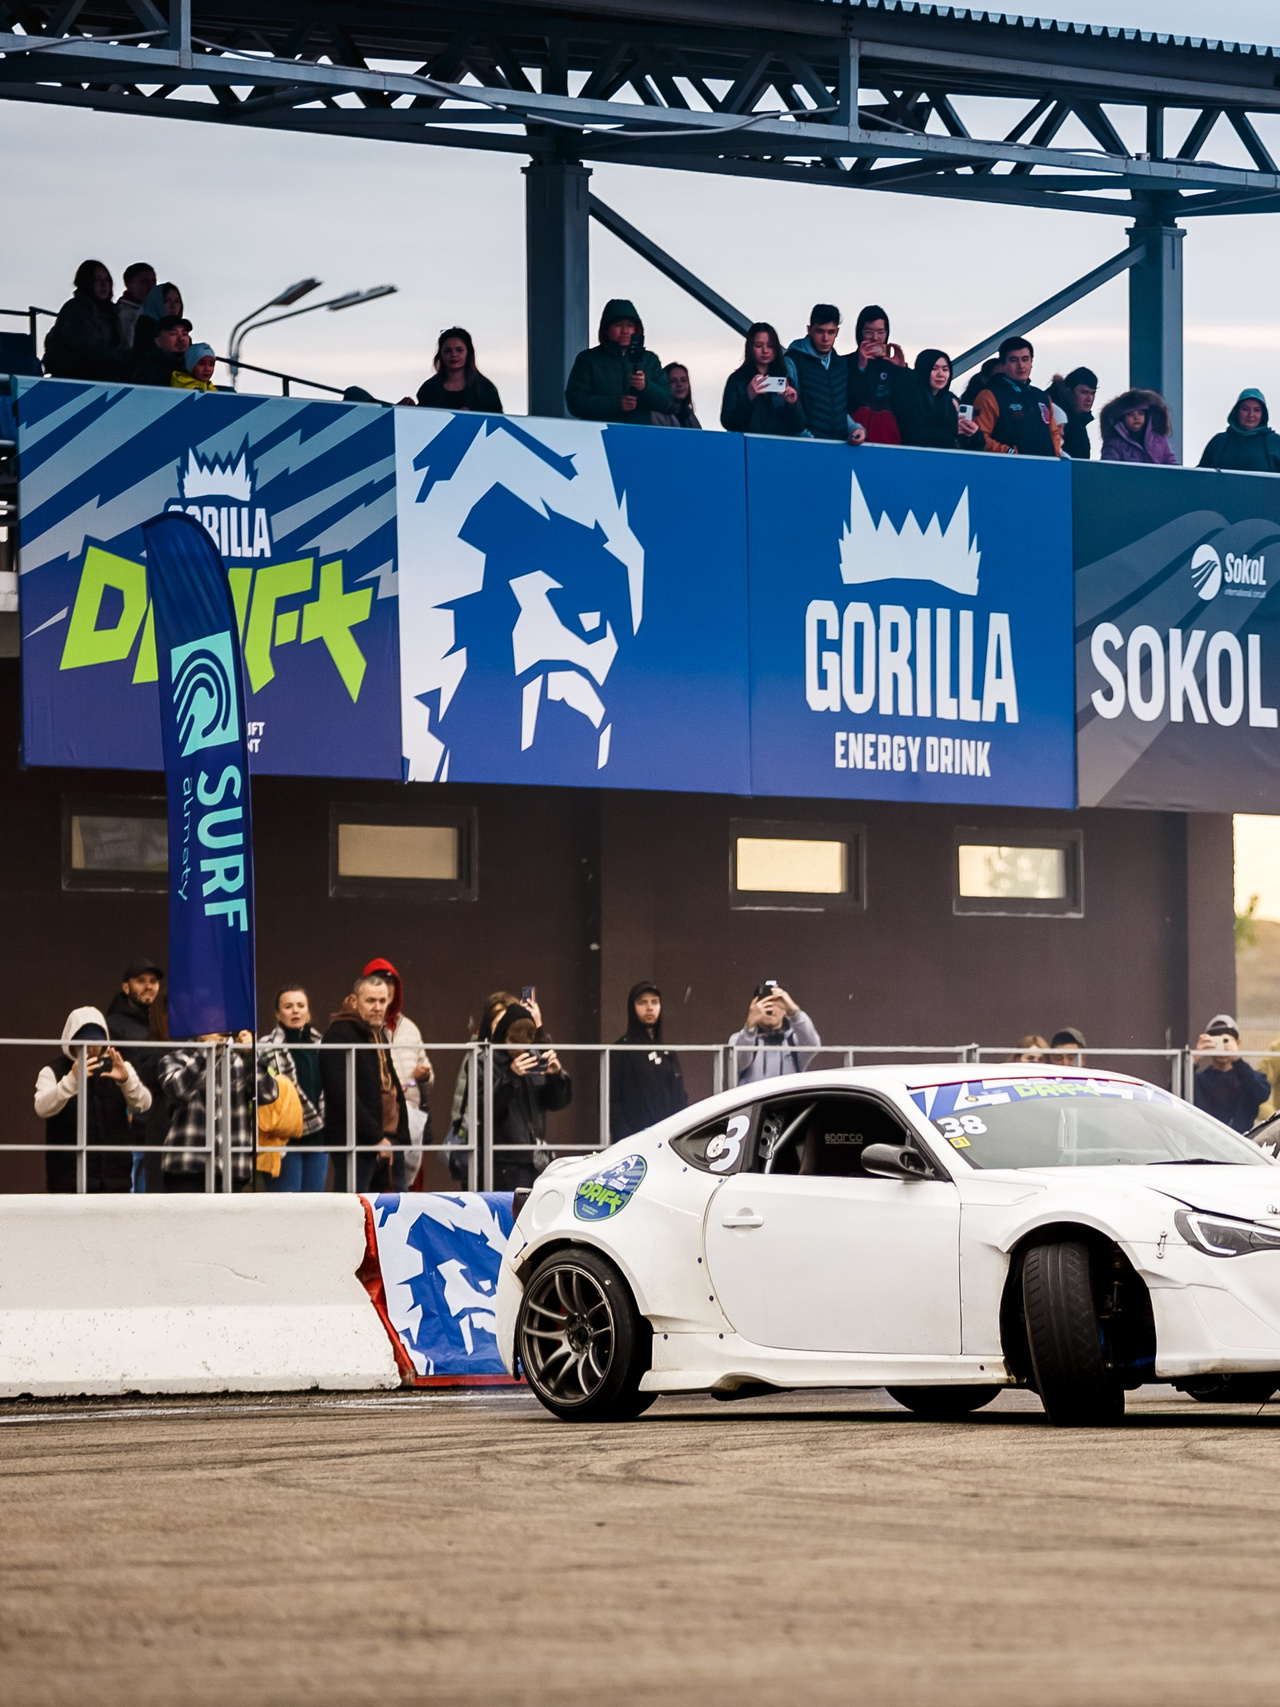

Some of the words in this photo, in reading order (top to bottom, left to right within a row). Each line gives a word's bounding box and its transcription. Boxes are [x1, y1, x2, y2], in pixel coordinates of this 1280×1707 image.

[167, 504, 272, 558] RILLA
[805, 599, 1019, 724] GORILLA
[834, 731, 922, 773] ENERGY
[925, 736, 991, 778] DRINK
[177, 777, 194, 901] almaty
[196, 764, 249, 932] SURF
[936, 1114, 988, 1139] 38
[578, 1180, 623, 1214] DRIFT
